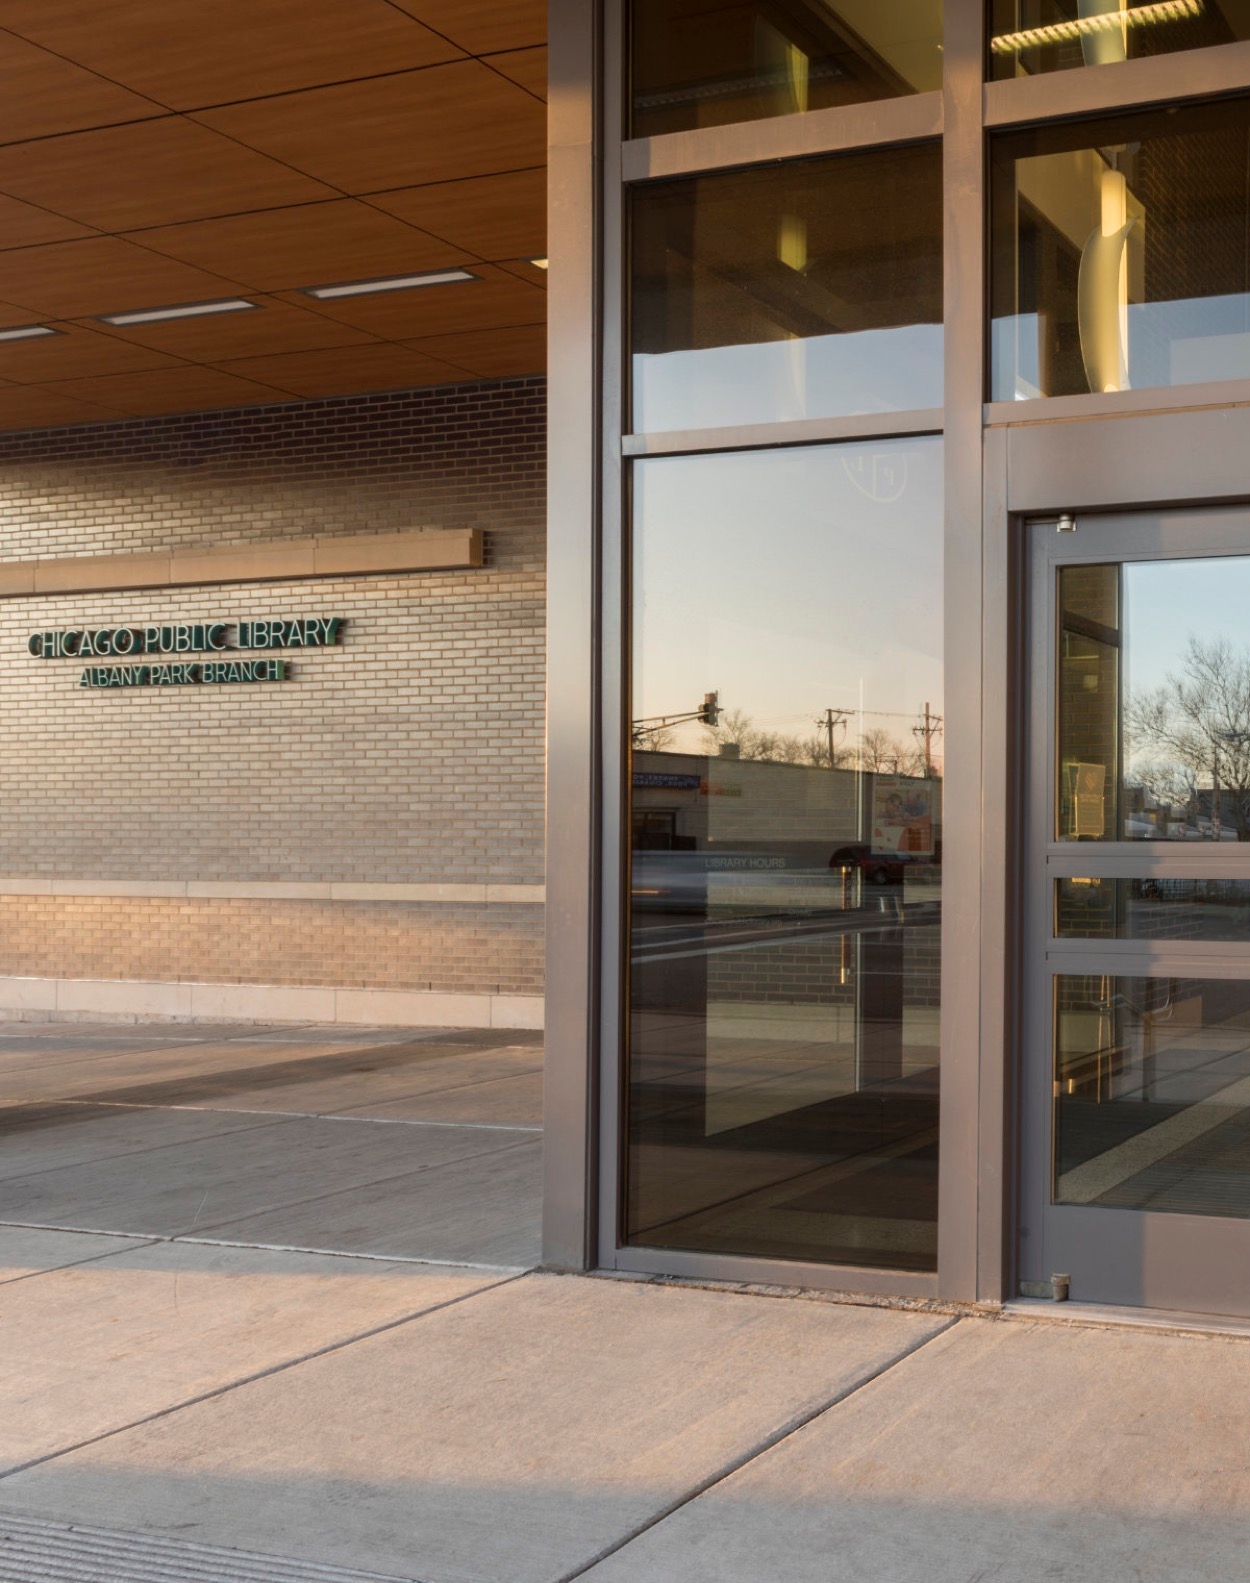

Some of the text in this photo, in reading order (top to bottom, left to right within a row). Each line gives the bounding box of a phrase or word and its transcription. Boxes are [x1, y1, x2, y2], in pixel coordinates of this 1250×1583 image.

[27, 617, 342, 659] CHICAGO PUBLIC LIBRARY
[79, 659, 286, 688] ALBANY PARK BRANCH
[705, 857, 786, 868] LIBRARY HOURS
